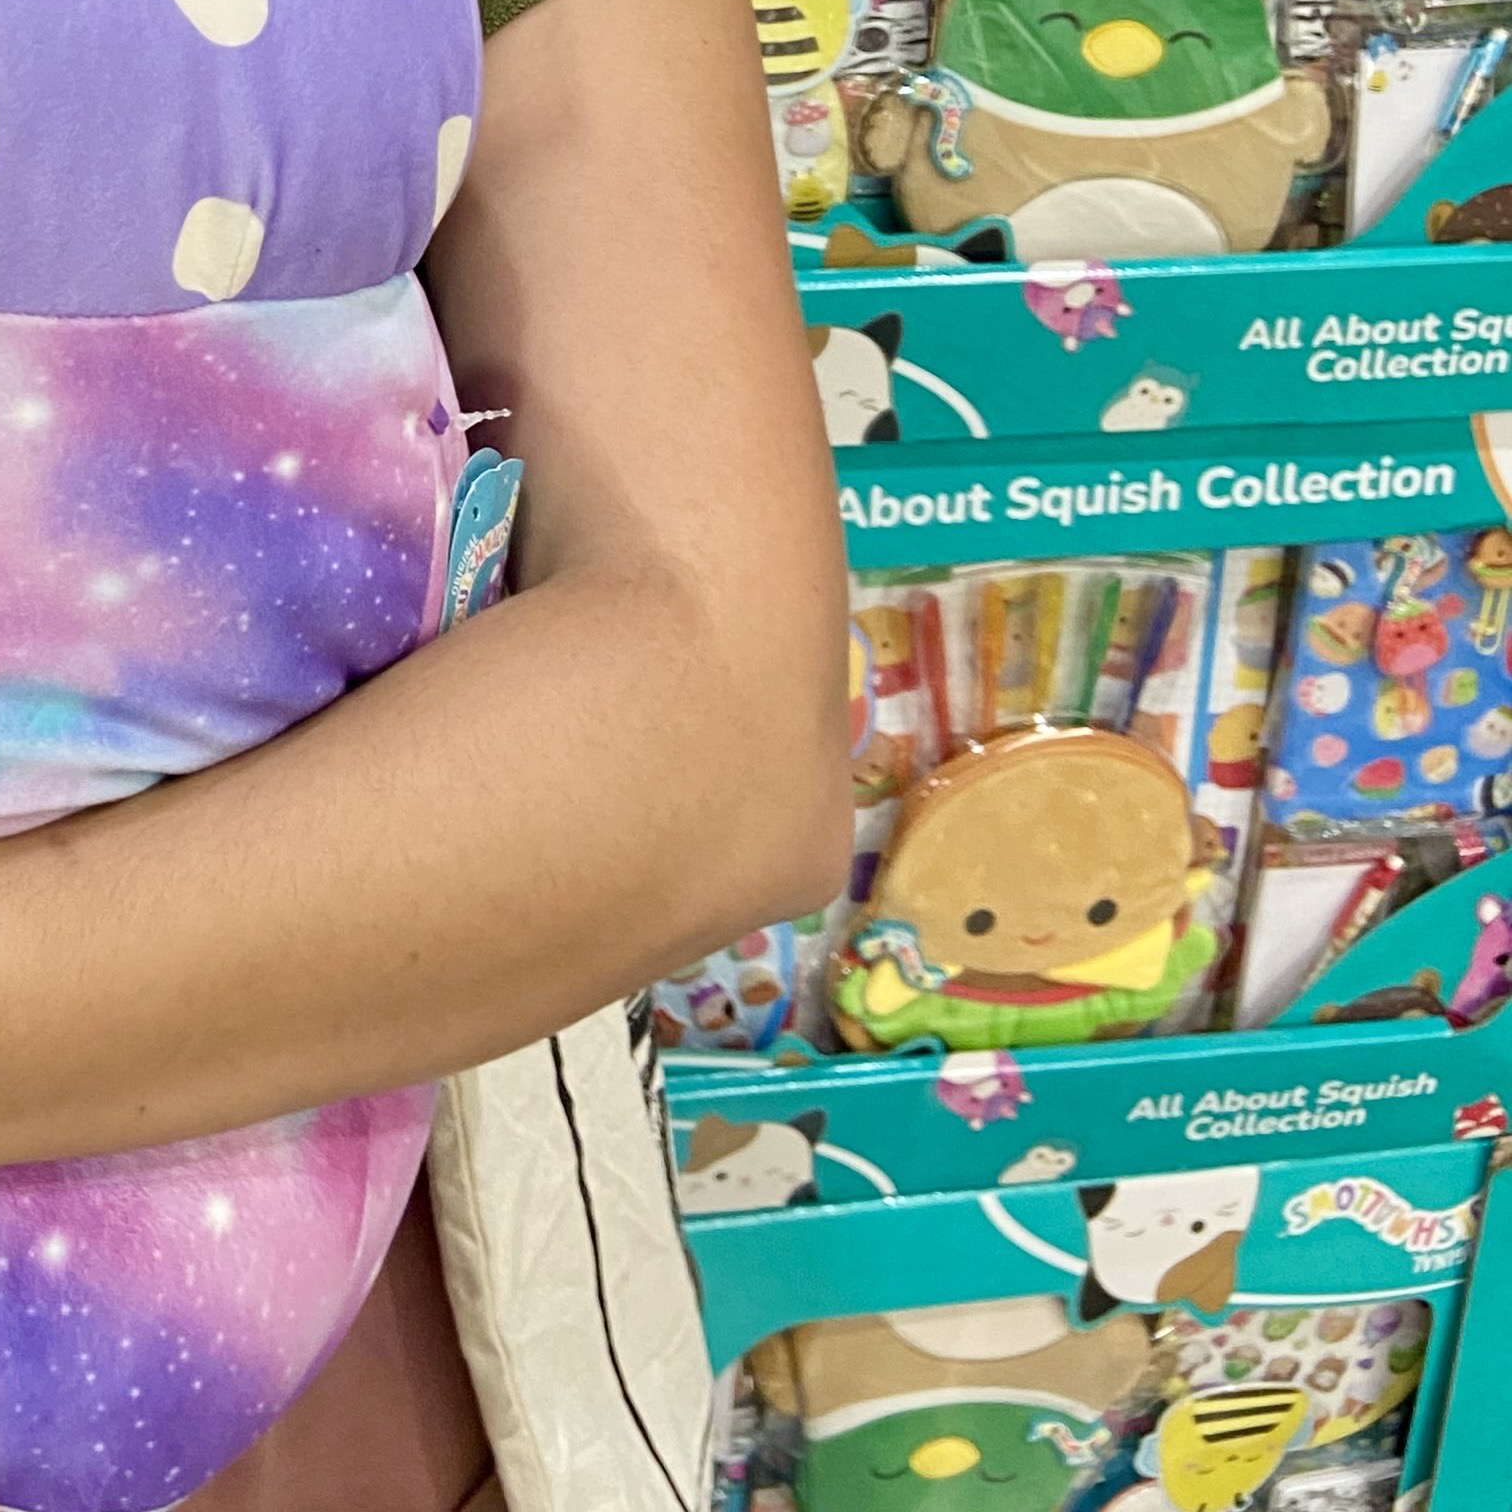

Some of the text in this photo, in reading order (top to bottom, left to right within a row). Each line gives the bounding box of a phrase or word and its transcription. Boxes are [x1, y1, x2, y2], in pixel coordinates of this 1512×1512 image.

[1239, 316, 1303, 351] All
[1311, 312, 1444, 348] About
[1306, 343, 1510, 383] Collection
[838, 455, 1456, 529] About Squish Collection
[1126, 1072, 1438, 1122] All About Squish
[1185, 1106, 1368, 1141] Collection
